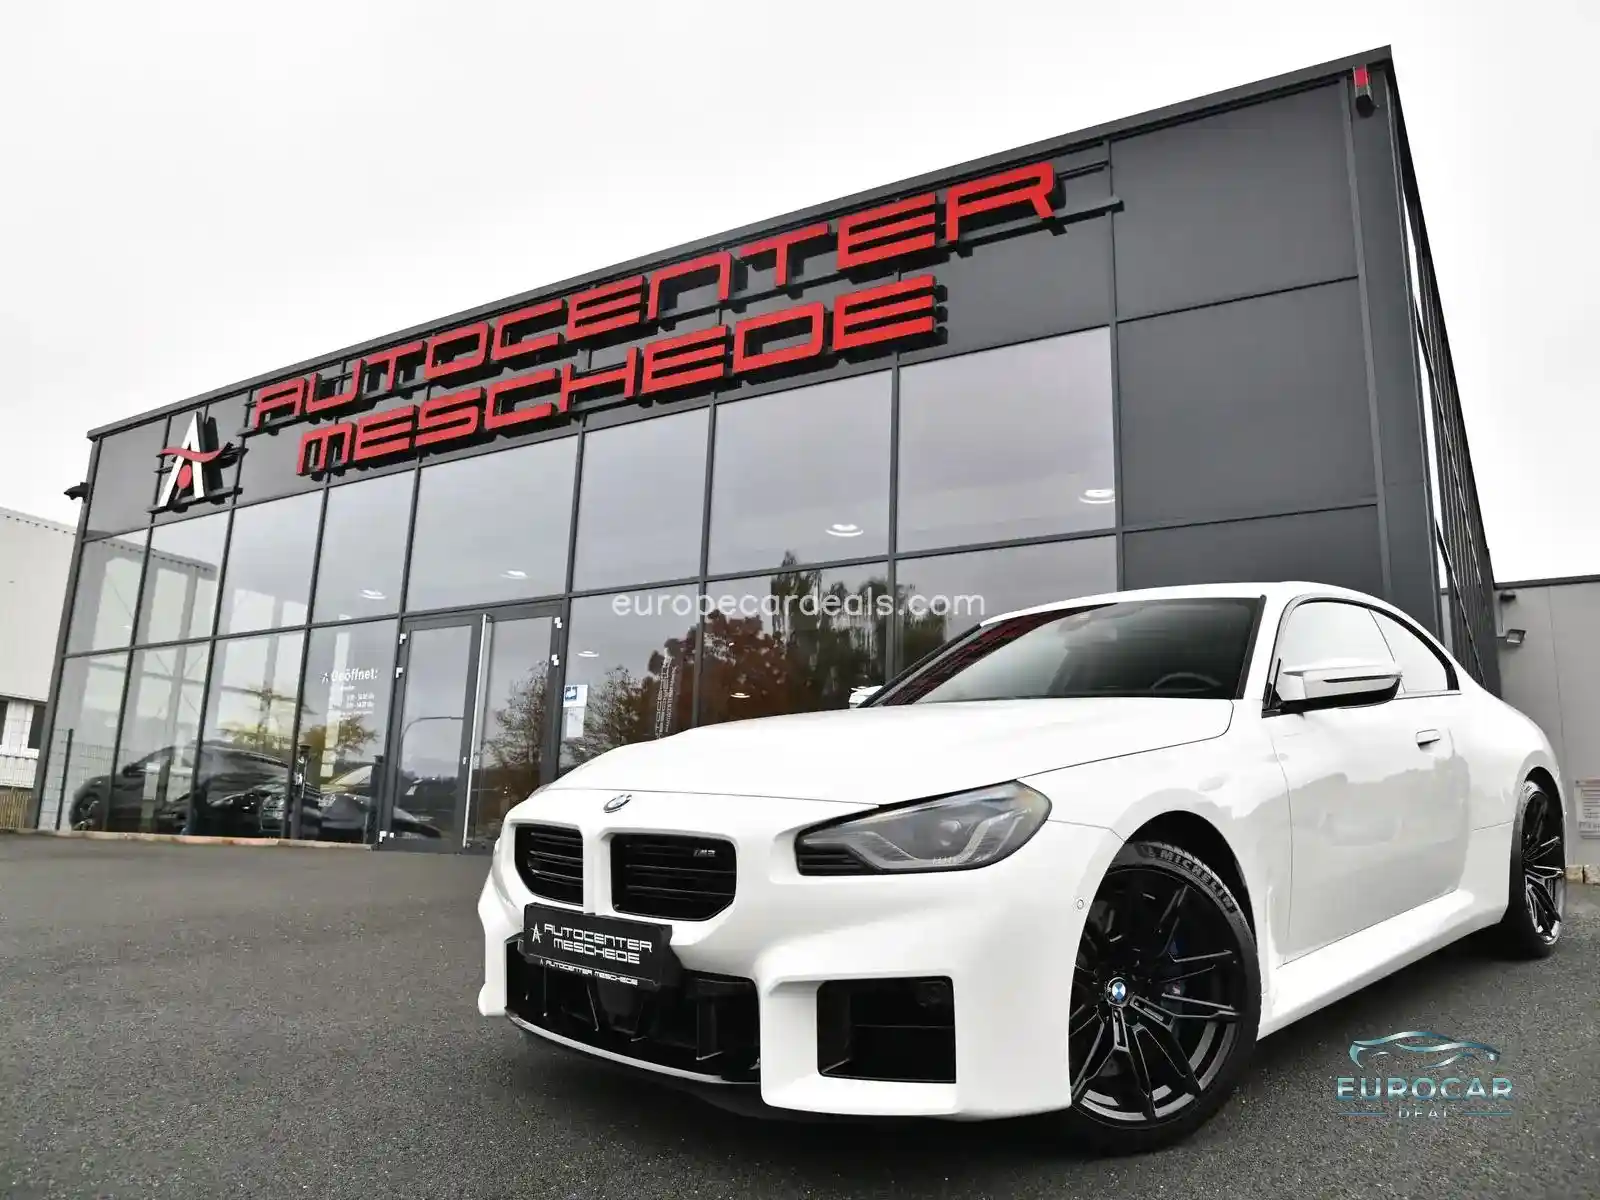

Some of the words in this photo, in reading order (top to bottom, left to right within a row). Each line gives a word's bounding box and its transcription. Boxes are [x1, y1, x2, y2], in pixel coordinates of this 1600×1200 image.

[248, 161, 1055, 428] AUTOCENTER
[296, 273, 936, 476] MESCHEDE
[1160, 850, 1238, 913] MICHELIN
[544, 923, 653, 952] AUTOCENTER
[553, 938, 640, 964] MESCHEDE
[545, 960, 593, 976] AUTOCENTER
[595, 971, 638, 986] MESCHEDE
